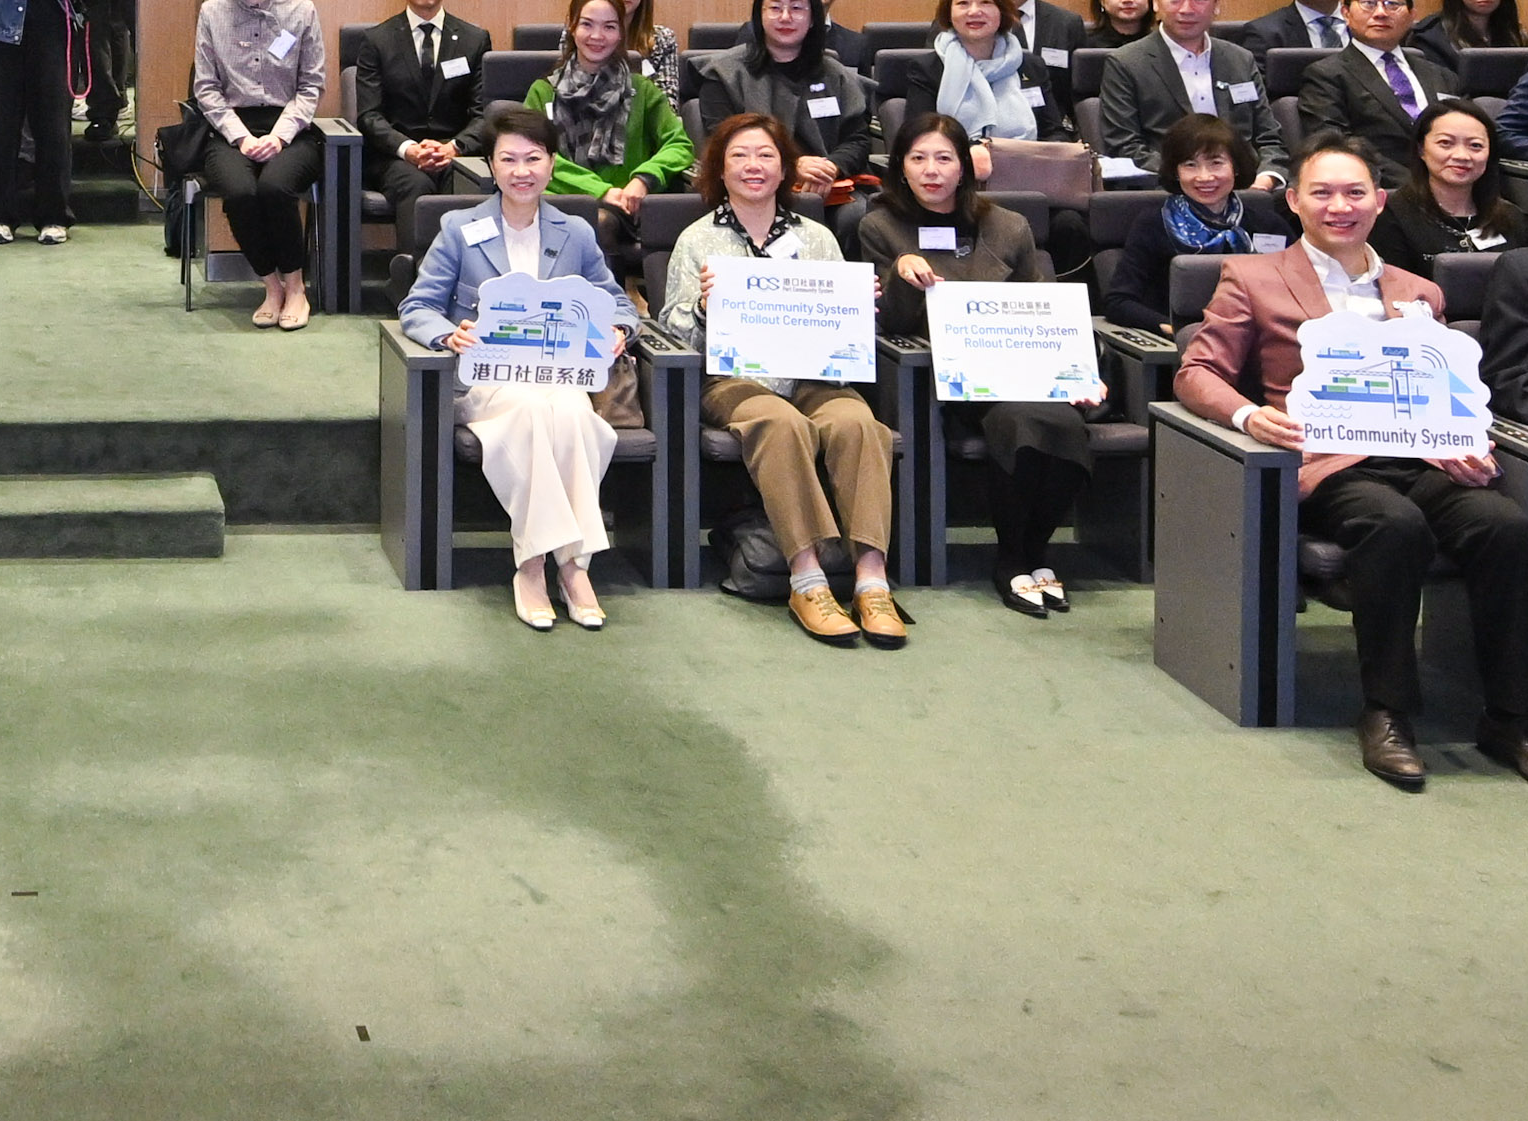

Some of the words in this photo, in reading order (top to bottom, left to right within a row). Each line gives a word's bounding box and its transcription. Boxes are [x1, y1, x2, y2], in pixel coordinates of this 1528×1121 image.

[747, 276, 780, 291] PCS
[722, 299, 746, 310] Port
[749, 300, 814, 315] Community
[816, 303, 859, 316] System
[967, 301, 999, 314] PCS
[741, 313, 780, 325] Rollout
[783, 315, 841, 330] Ceremony
[945, 324, 968, 335] Port
[971, 325, 1034, 338] Community
[1036, 326, 1078, 338] System
[964, 338, 1002, 349] Rollout
[1006, 339, 1062, 351] Ceremony
[472, 362, 596, 387] 港口社區系統
[1304, 423, 1333, 440] Port
[1337, 425, 1417, 448] Community
[1421, 429, 1474, 449] System
